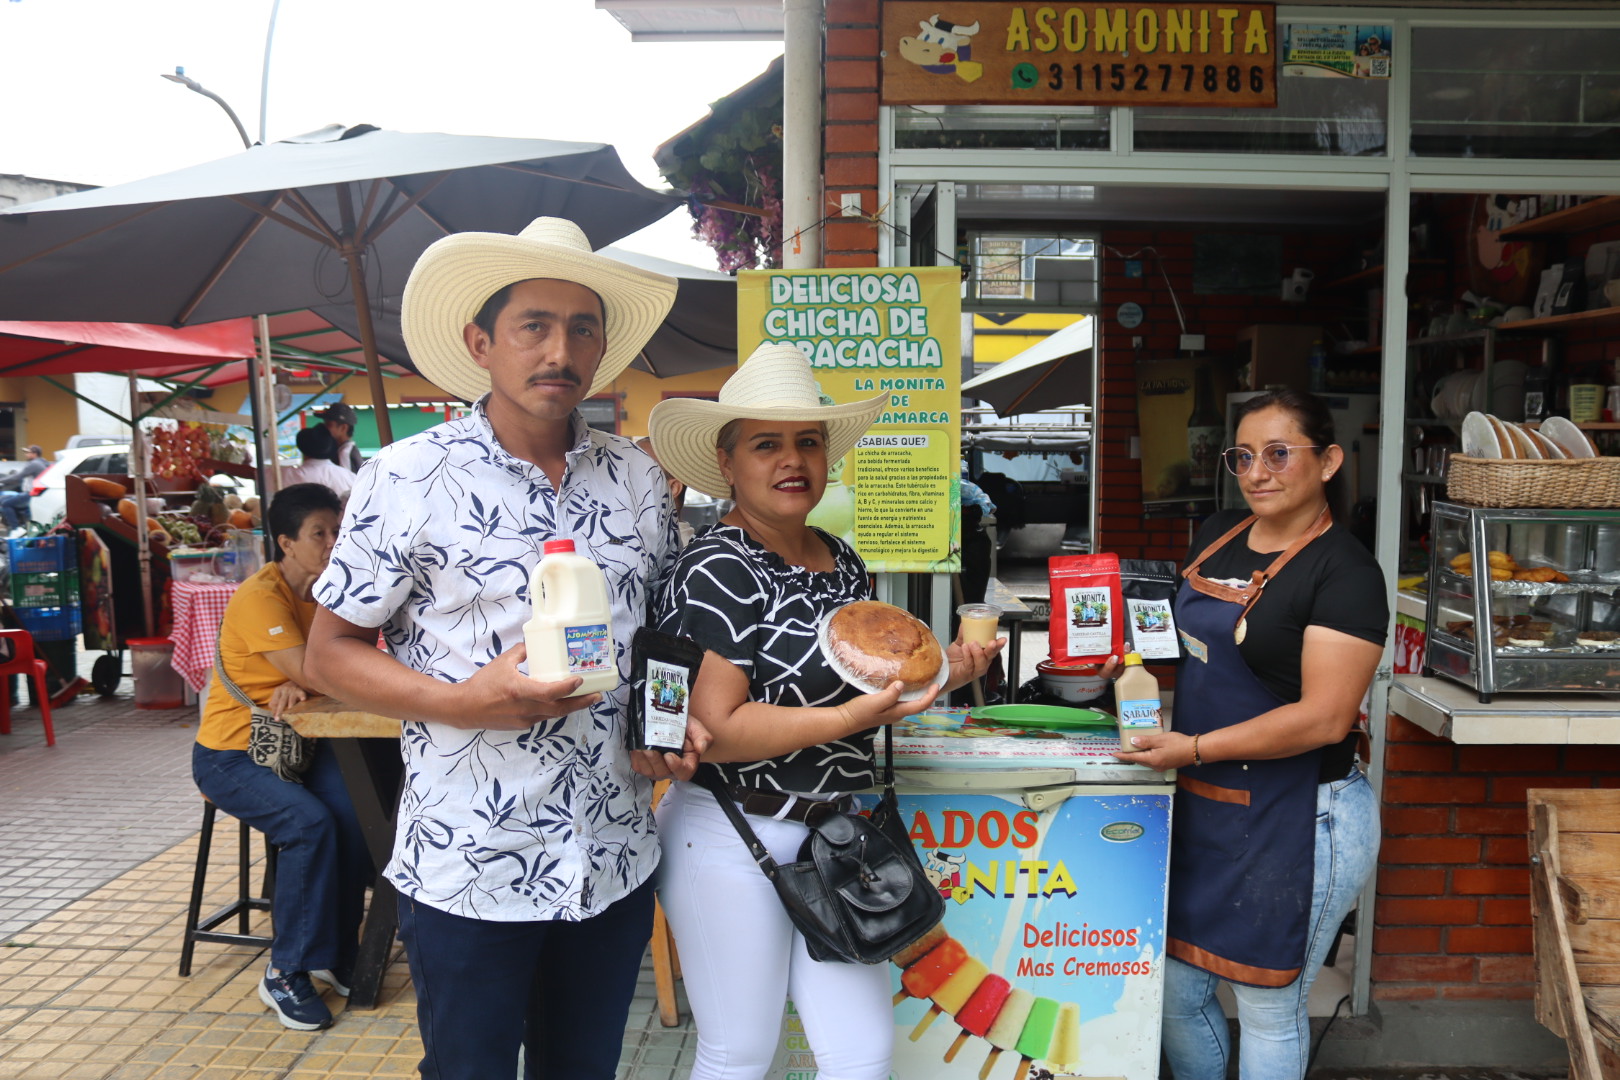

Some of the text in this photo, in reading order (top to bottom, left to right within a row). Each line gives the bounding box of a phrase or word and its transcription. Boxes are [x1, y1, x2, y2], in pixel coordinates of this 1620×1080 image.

[1006, 8, 1268, 54] ASOMONITA
[1049, 63, 1264, 93] 3115277886
[771, 273, 920, 304] DELICIOSA
[764, 306, 927, 337] CHICHA DE
[762, 338, 942, 368] RACACHA
[855, 378, 945, 390] LA MONITA
[891, 396, 909, 407] DE
[874, 412, 949, 424] AMARCA
[858, 437, 926, 447] ¿SABIAS QUE?
[1072, 595, 1080, 603] LA
[1082, 593, 1106, 602] MONITA
[652, 669, 659, 680] LA
[661, 671, 684, 686] MONITA
[1123, 708, 1162, 721] SABAJÓN
[908, 810, 1040, 849] ADOS
[966, 859, 1078, 899] NITA
[1023, 922, 1140, 948] Deliciosos
[1017, 956, 1150, 977] Mas Cremosos
